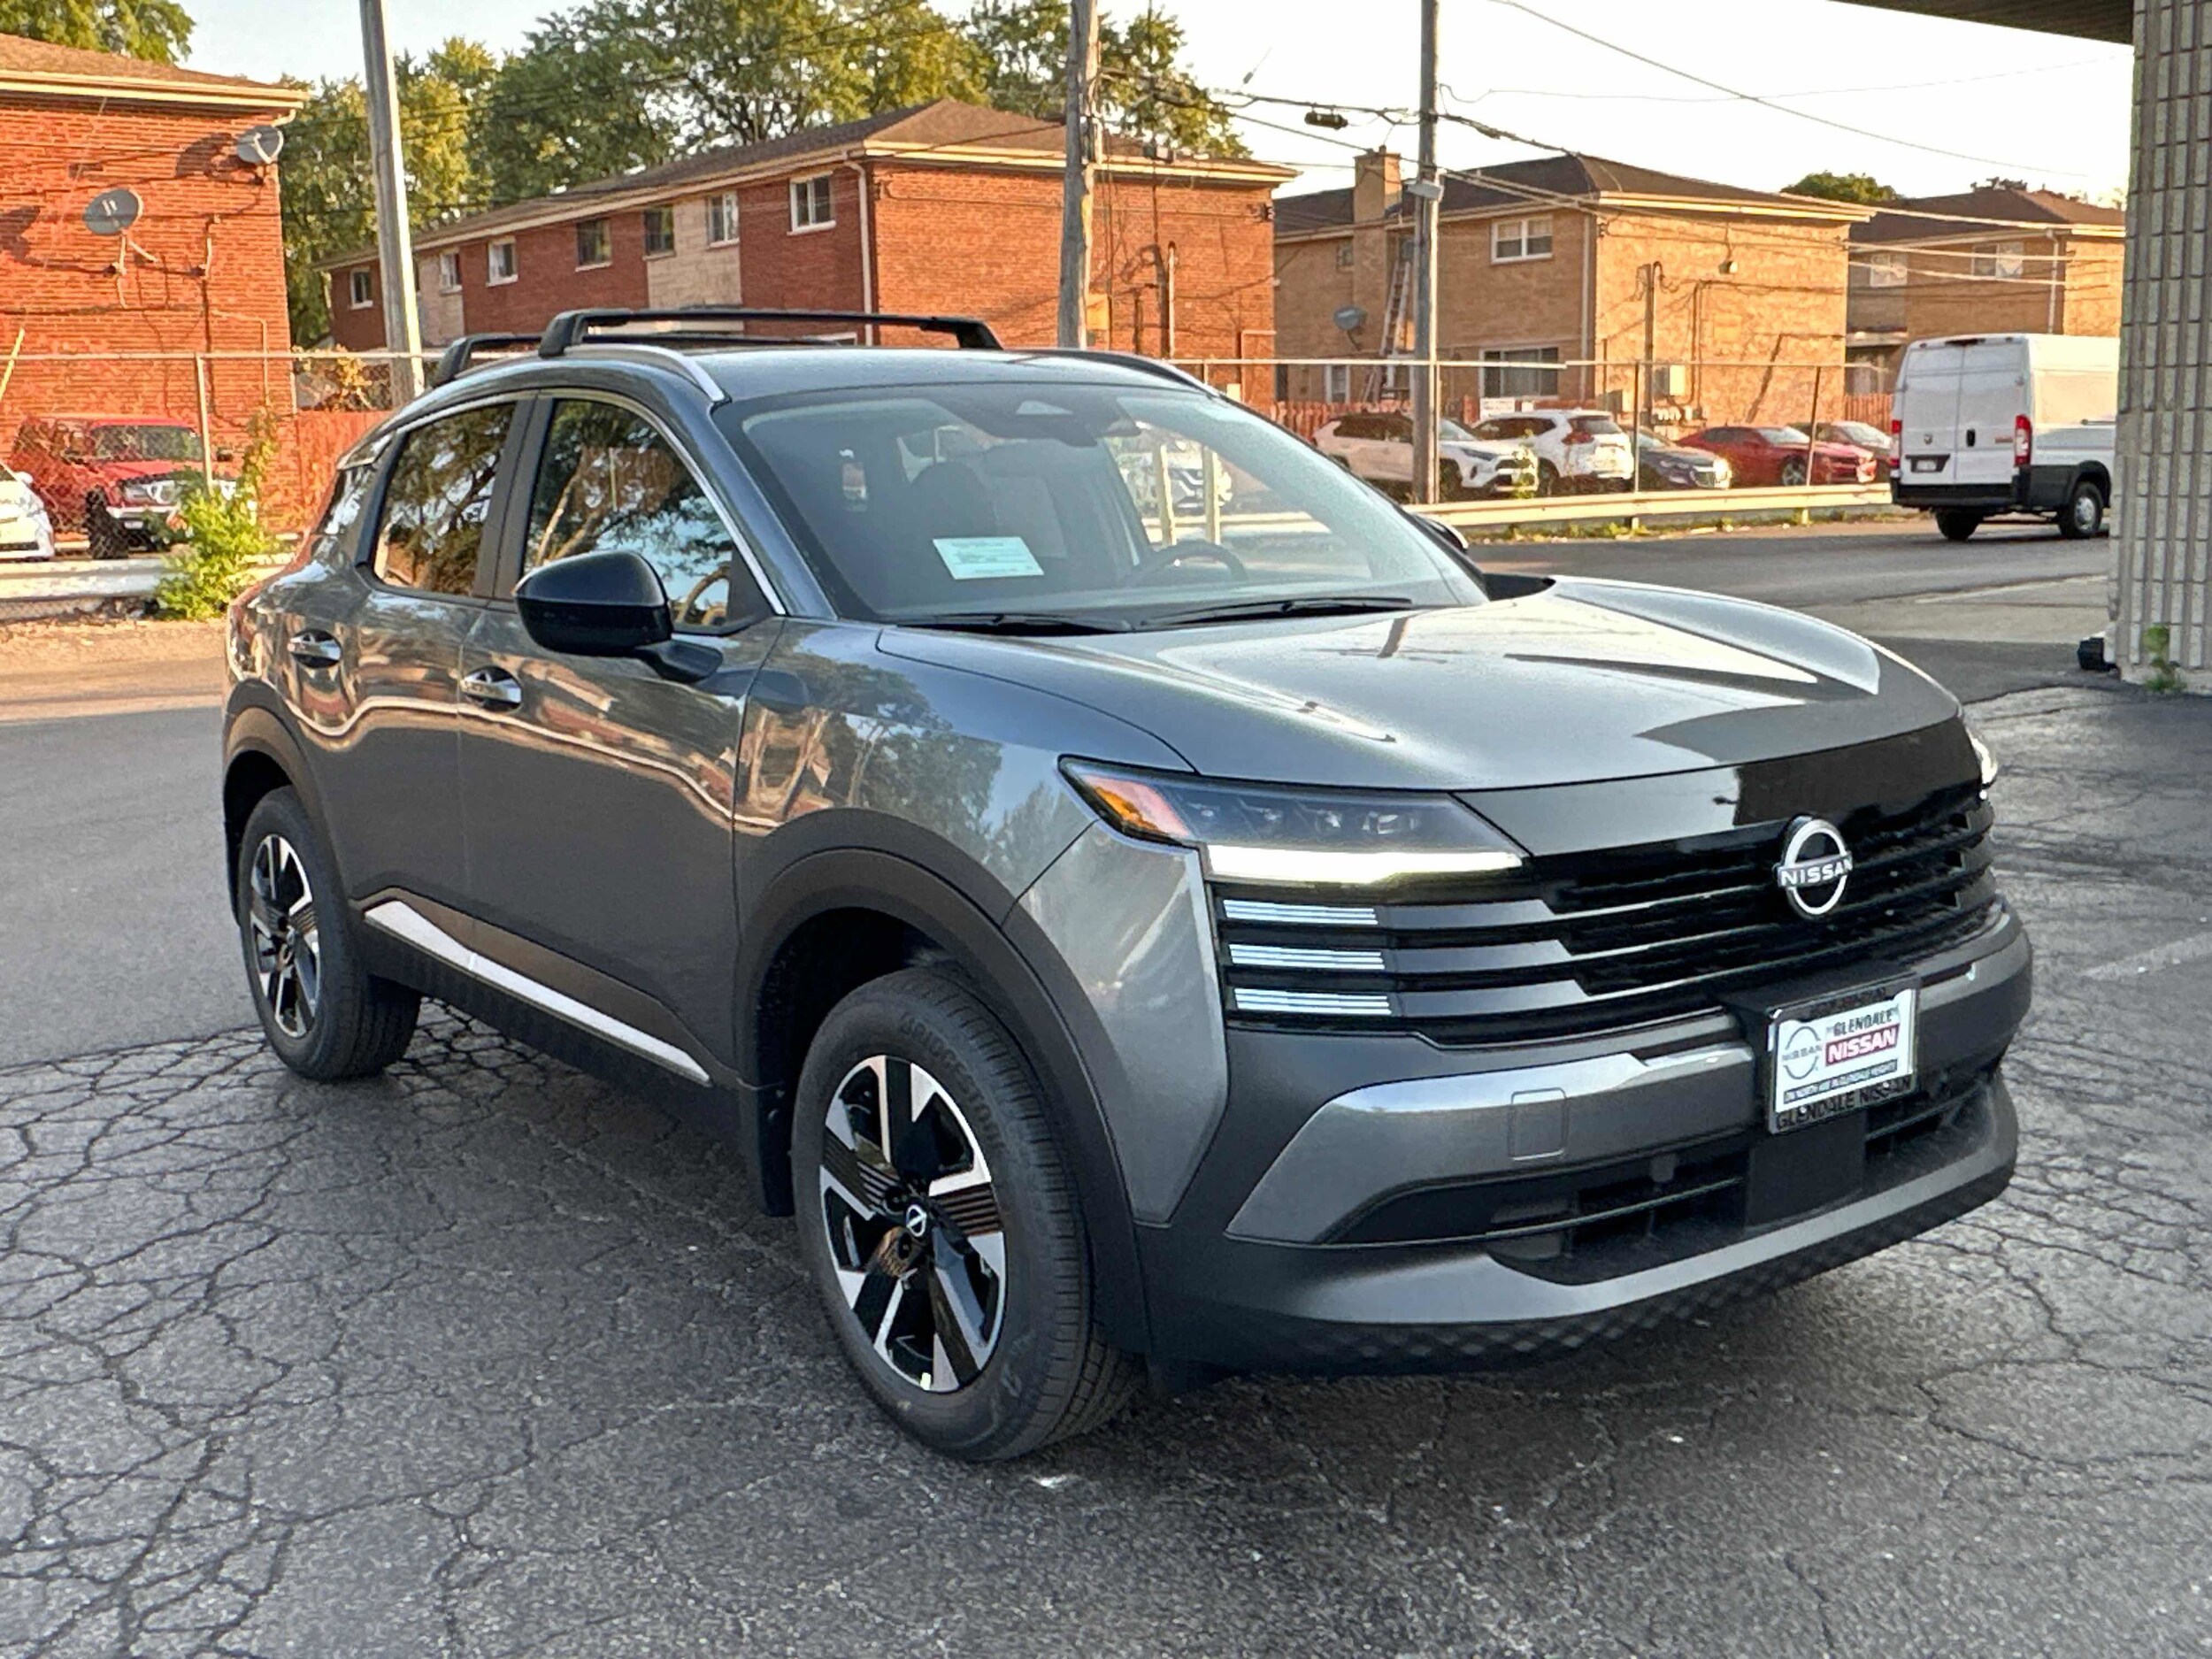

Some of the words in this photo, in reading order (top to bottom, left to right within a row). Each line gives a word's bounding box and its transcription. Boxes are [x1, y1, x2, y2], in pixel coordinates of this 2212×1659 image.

[1781, 858, 1852, 886] NISSAN
[1833, 1009, 1893, 1036] GLENDALE
[1828, 1027, 1896, 1062] NISSAN
[1778, 1092, 1854, 1130] GLENDALE
[1859, 1076, 1910, 1104] NISSAN
